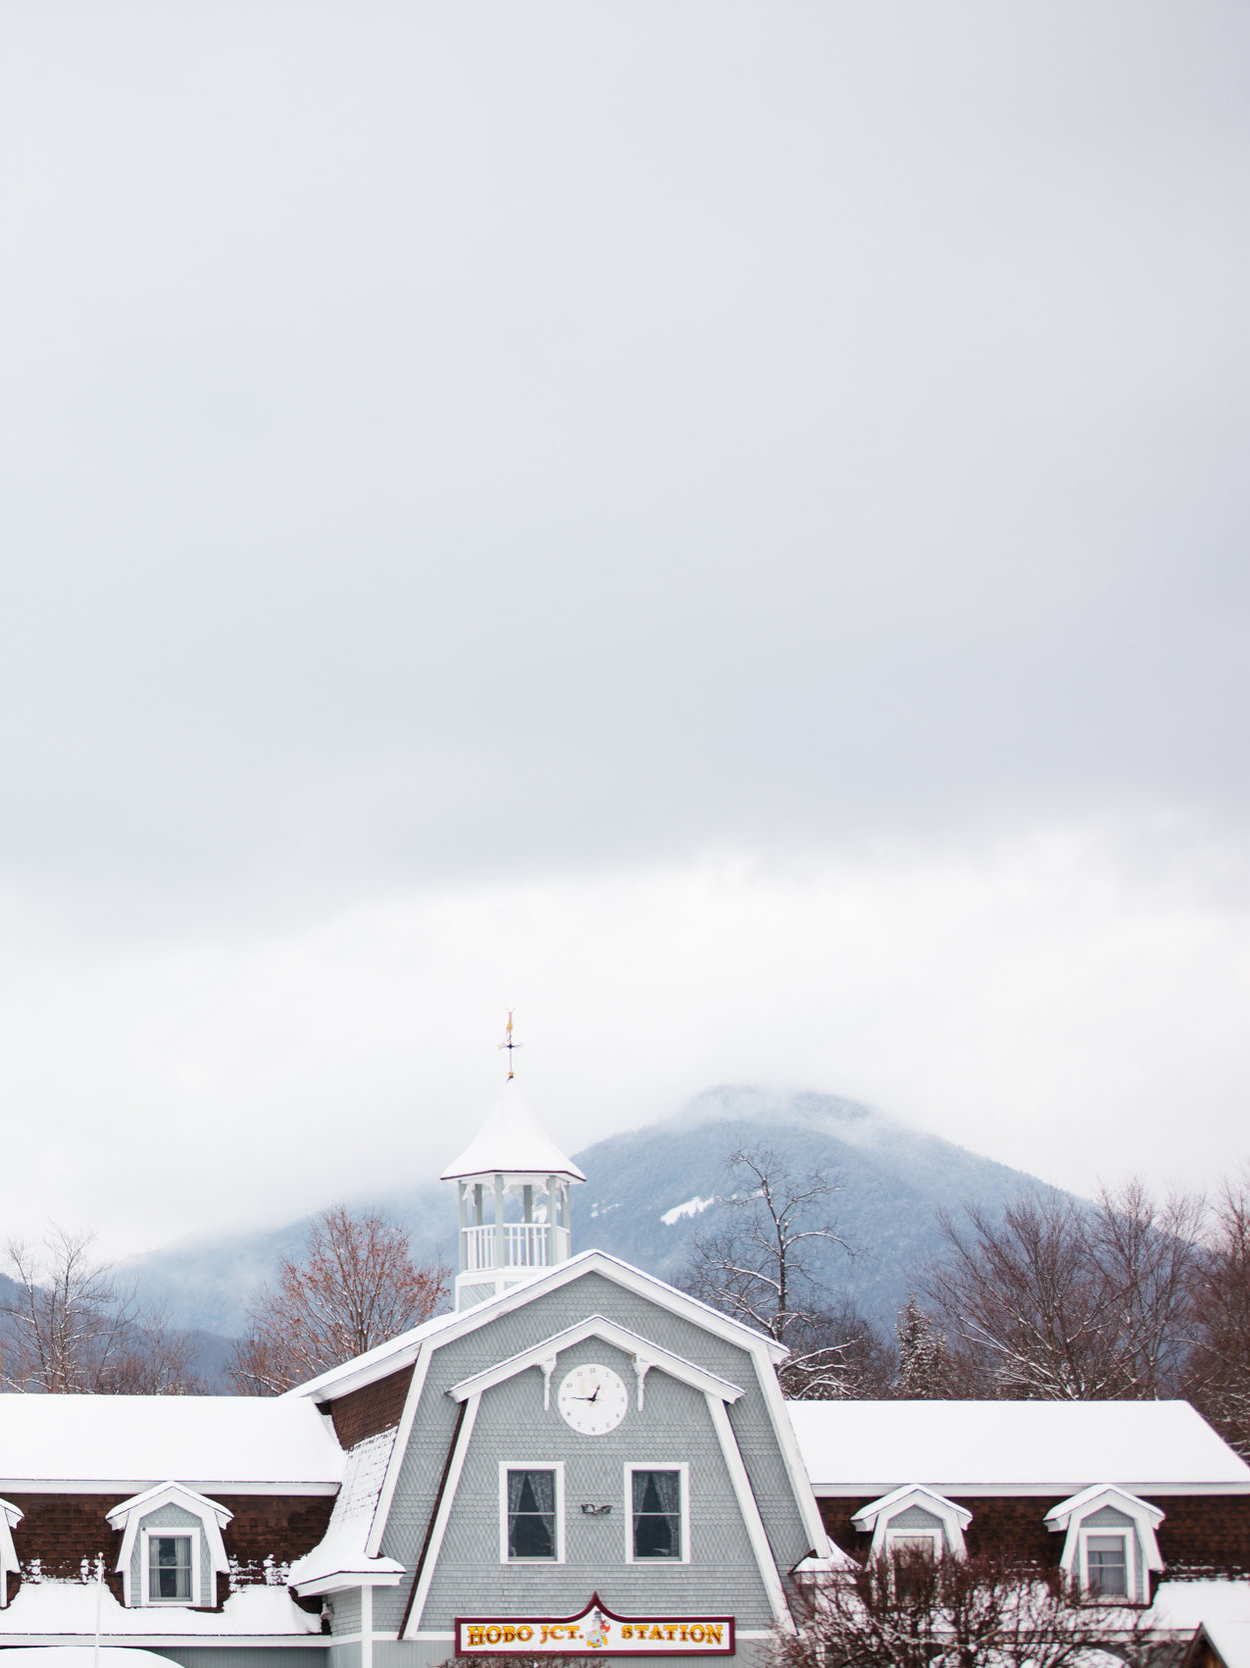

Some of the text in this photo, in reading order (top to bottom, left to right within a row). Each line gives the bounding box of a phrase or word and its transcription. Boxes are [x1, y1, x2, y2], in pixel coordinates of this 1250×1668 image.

[467, 1624, 723, 1647] HOBO JCT. STATION
